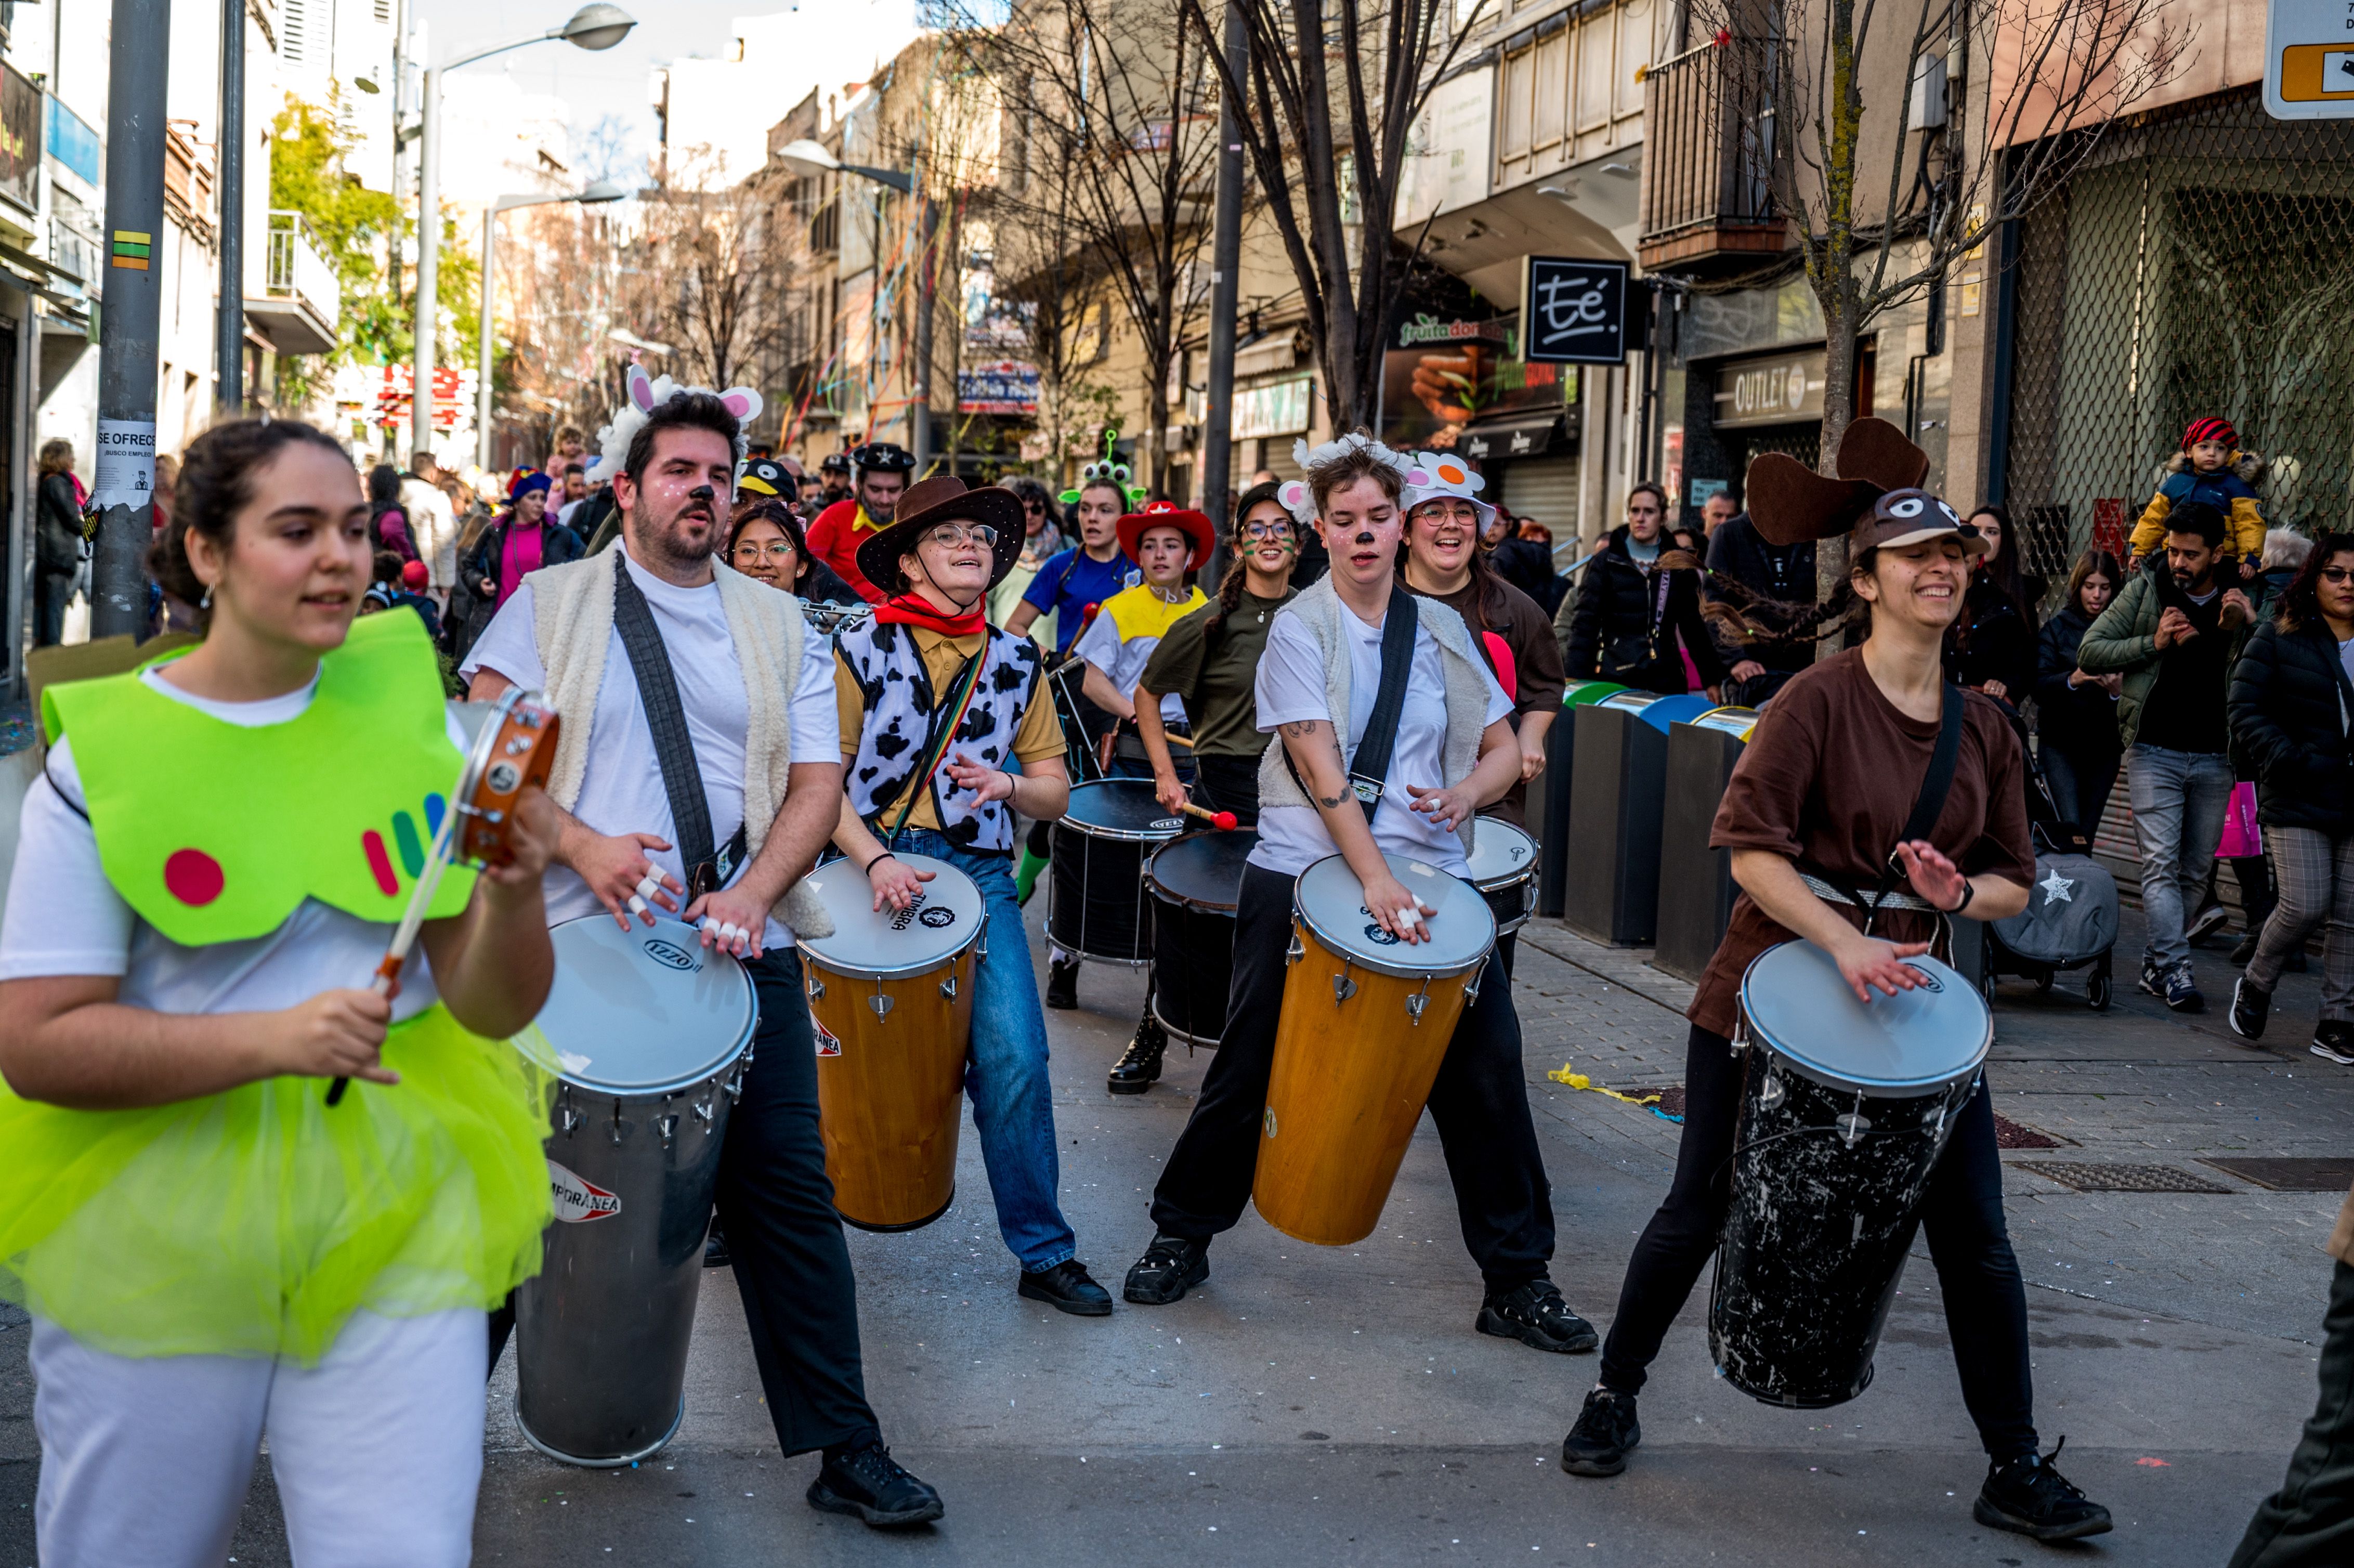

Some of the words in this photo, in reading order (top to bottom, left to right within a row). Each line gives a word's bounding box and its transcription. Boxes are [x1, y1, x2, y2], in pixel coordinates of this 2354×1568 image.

[1735, 367, 1787, 412] OUTLET
[98, 433, 109, 443] SE
[112, 433, 155, 446] OFRECE
[891, 894, 927, 931] TIMBRA
[648, 943, 690, 966] IZZO
